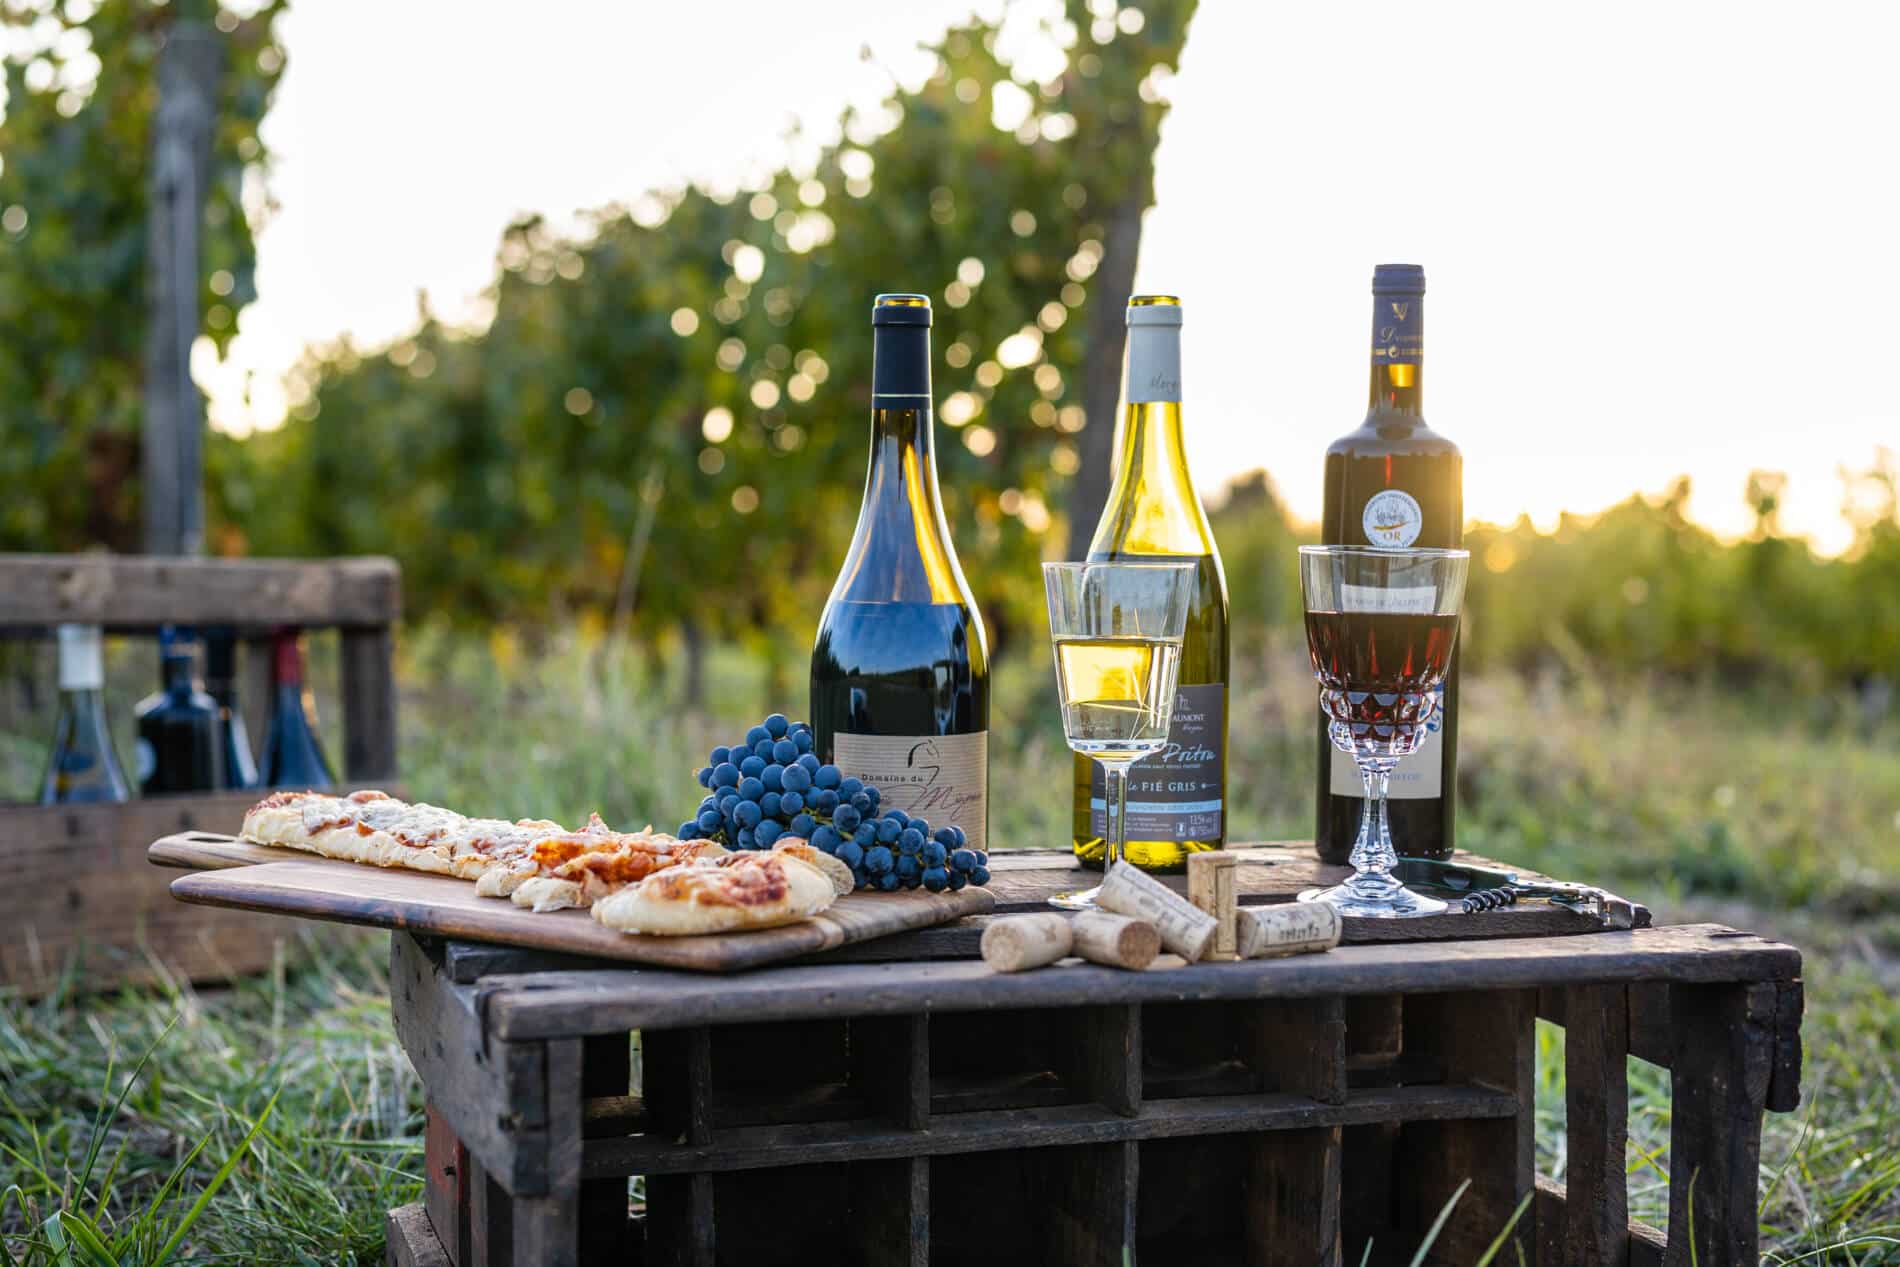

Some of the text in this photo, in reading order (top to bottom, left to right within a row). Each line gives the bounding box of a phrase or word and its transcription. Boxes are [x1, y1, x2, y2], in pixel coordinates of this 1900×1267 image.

[1383, 531, 1401, 541] OR
[1172, 714, 1205, 722] AUMONT
[862, 773, 924, 782] Domaine du
[1168, 781, 1196, 792] GRIS
